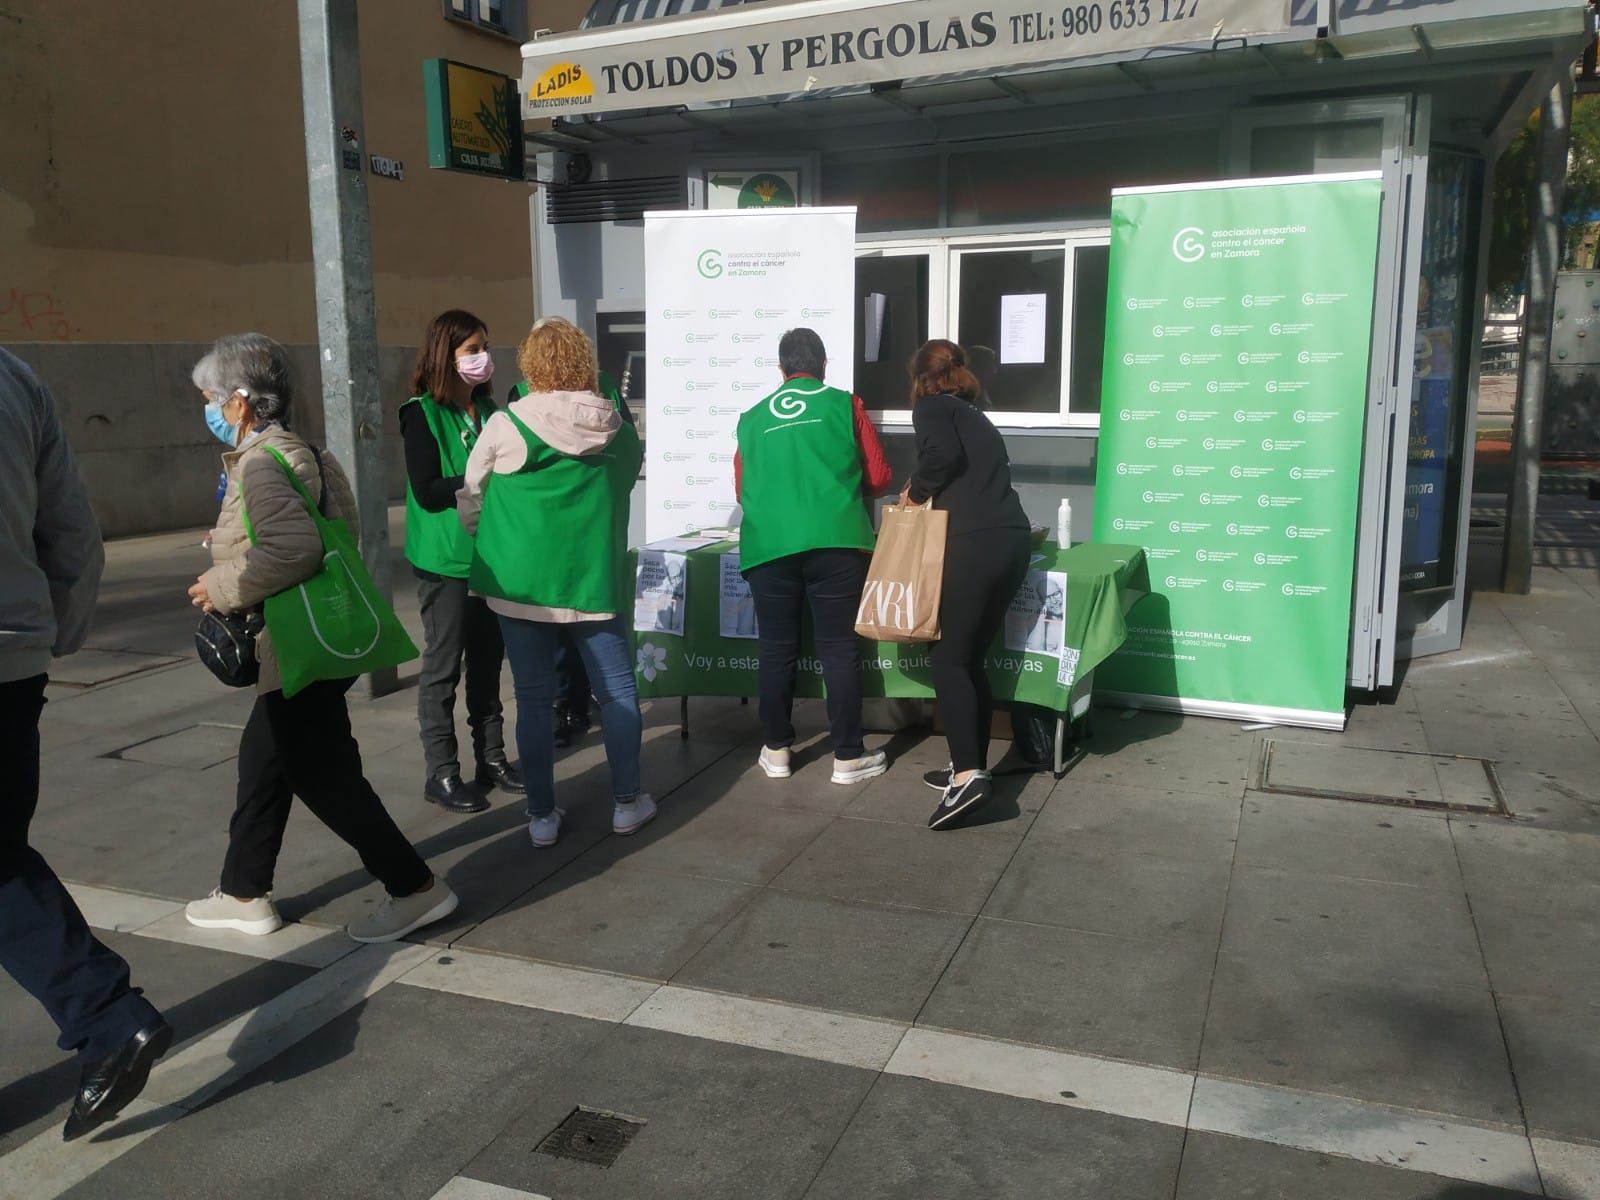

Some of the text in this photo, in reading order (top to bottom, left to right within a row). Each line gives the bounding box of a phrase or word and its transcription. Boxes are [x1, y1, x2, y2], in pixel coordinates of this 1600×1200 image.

[601, 49, 738, 95] TOLDOS
[747, 43, 770, 76] Y
[782, 11, 997, 72] PERGOLAS
[1009, 12, 1055, 45] TEL:
[1062, 3, 1102, 38] 980
[1109, 0, 1150, 31] 633
[537, 64, 582, 97] LADIS
[570, 95, 593, 106] SOLAR
[1211, 224, 1307, 238] asociación española
[1211, 238, 1241, 248] contra
[1242, 237, 1252, 247] el
[1210, 248, 1261, 259] en Zamora
[727, 260, 752, 268] contra
[738, 268, 767, 277] Zamora
[854, 580, 914, 631] ZARA
[1185, 631, 1213, 640] CONTRA
[1213, 632, 1223, 641] EL
[684, 653, 713, 672] Voy
[717, 656, 727, 668] a
[729, 656, 760, 670] esta
[899, 654, 934, 672] quie
[993, 656, 1044, 674] vayas
